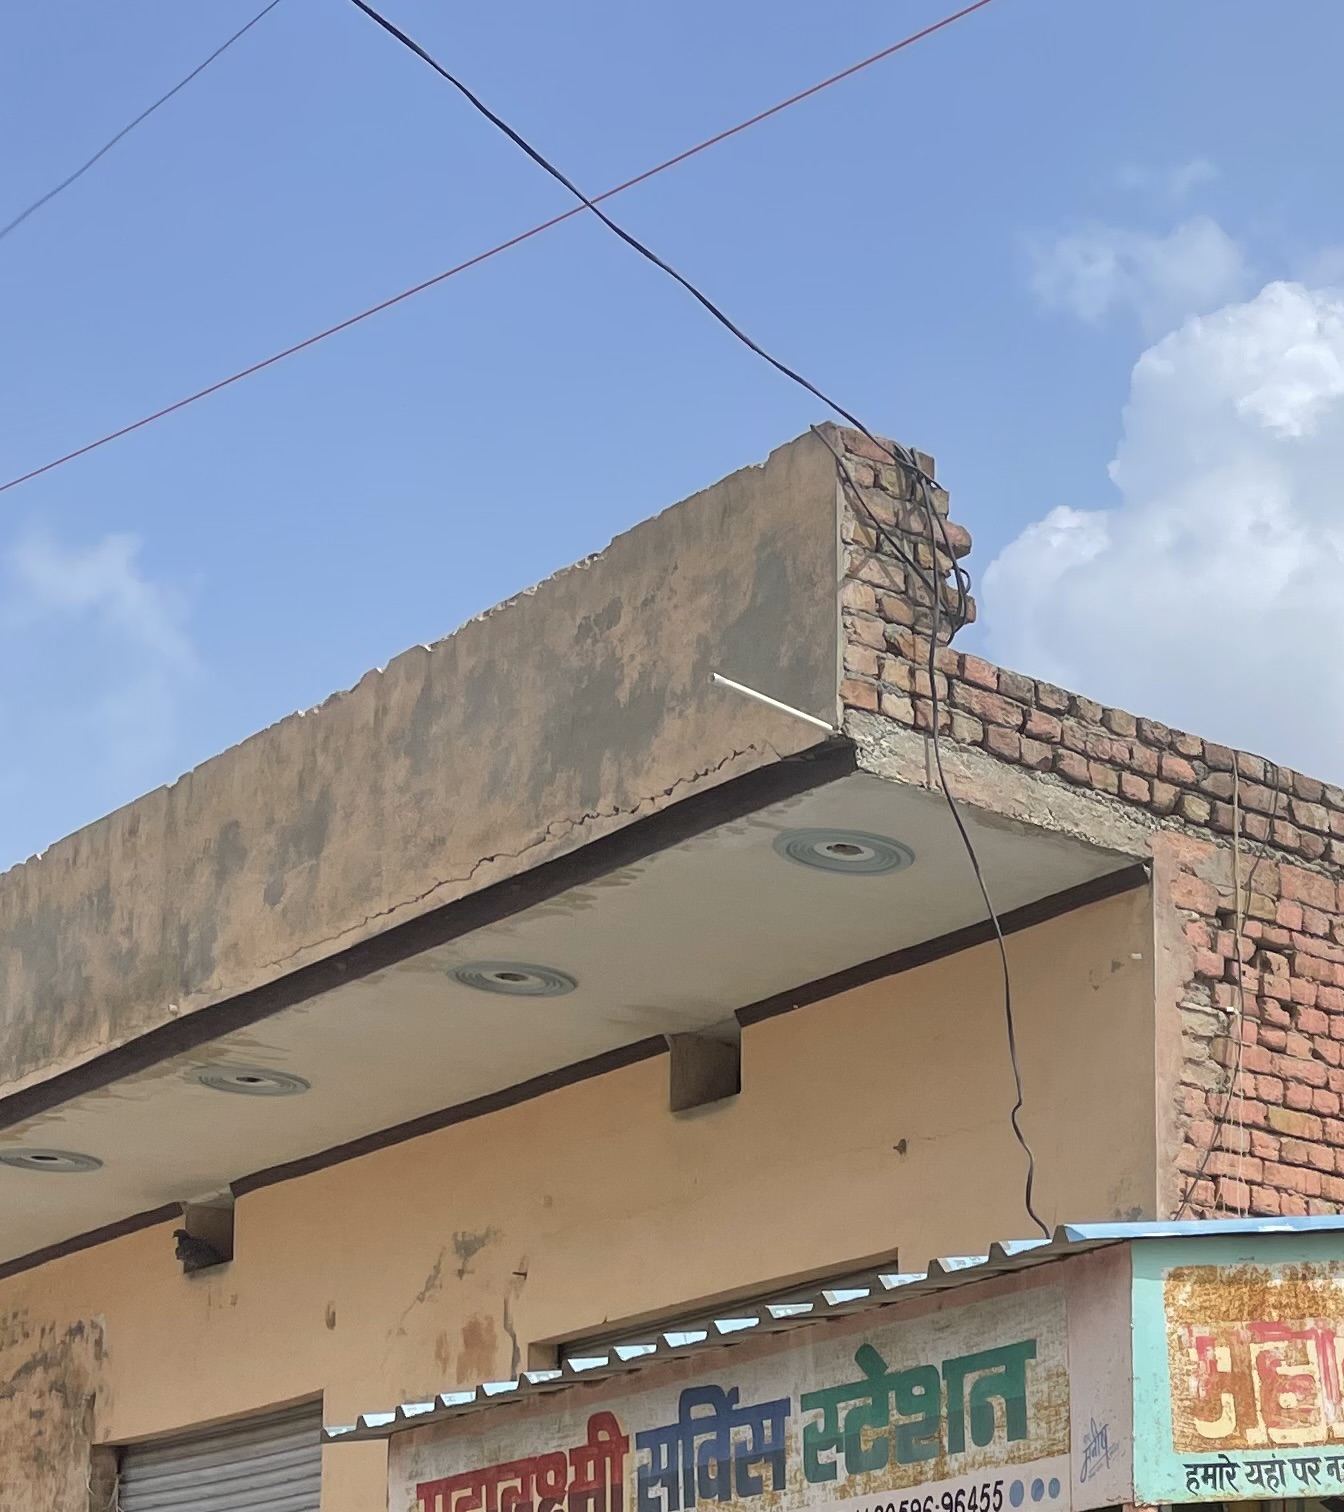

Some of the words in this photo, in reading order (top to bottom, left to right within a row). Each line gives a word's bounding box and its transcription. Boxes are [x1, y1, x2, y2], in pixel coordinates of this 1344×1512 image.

[800, 1339, 1037, 1483] स्टेशन
[1183, 1454, 1241, 1496] हमारे
[1243, 1453, 1288, 1493] यहां
[1288, 1456, 1322, 1486] पर
